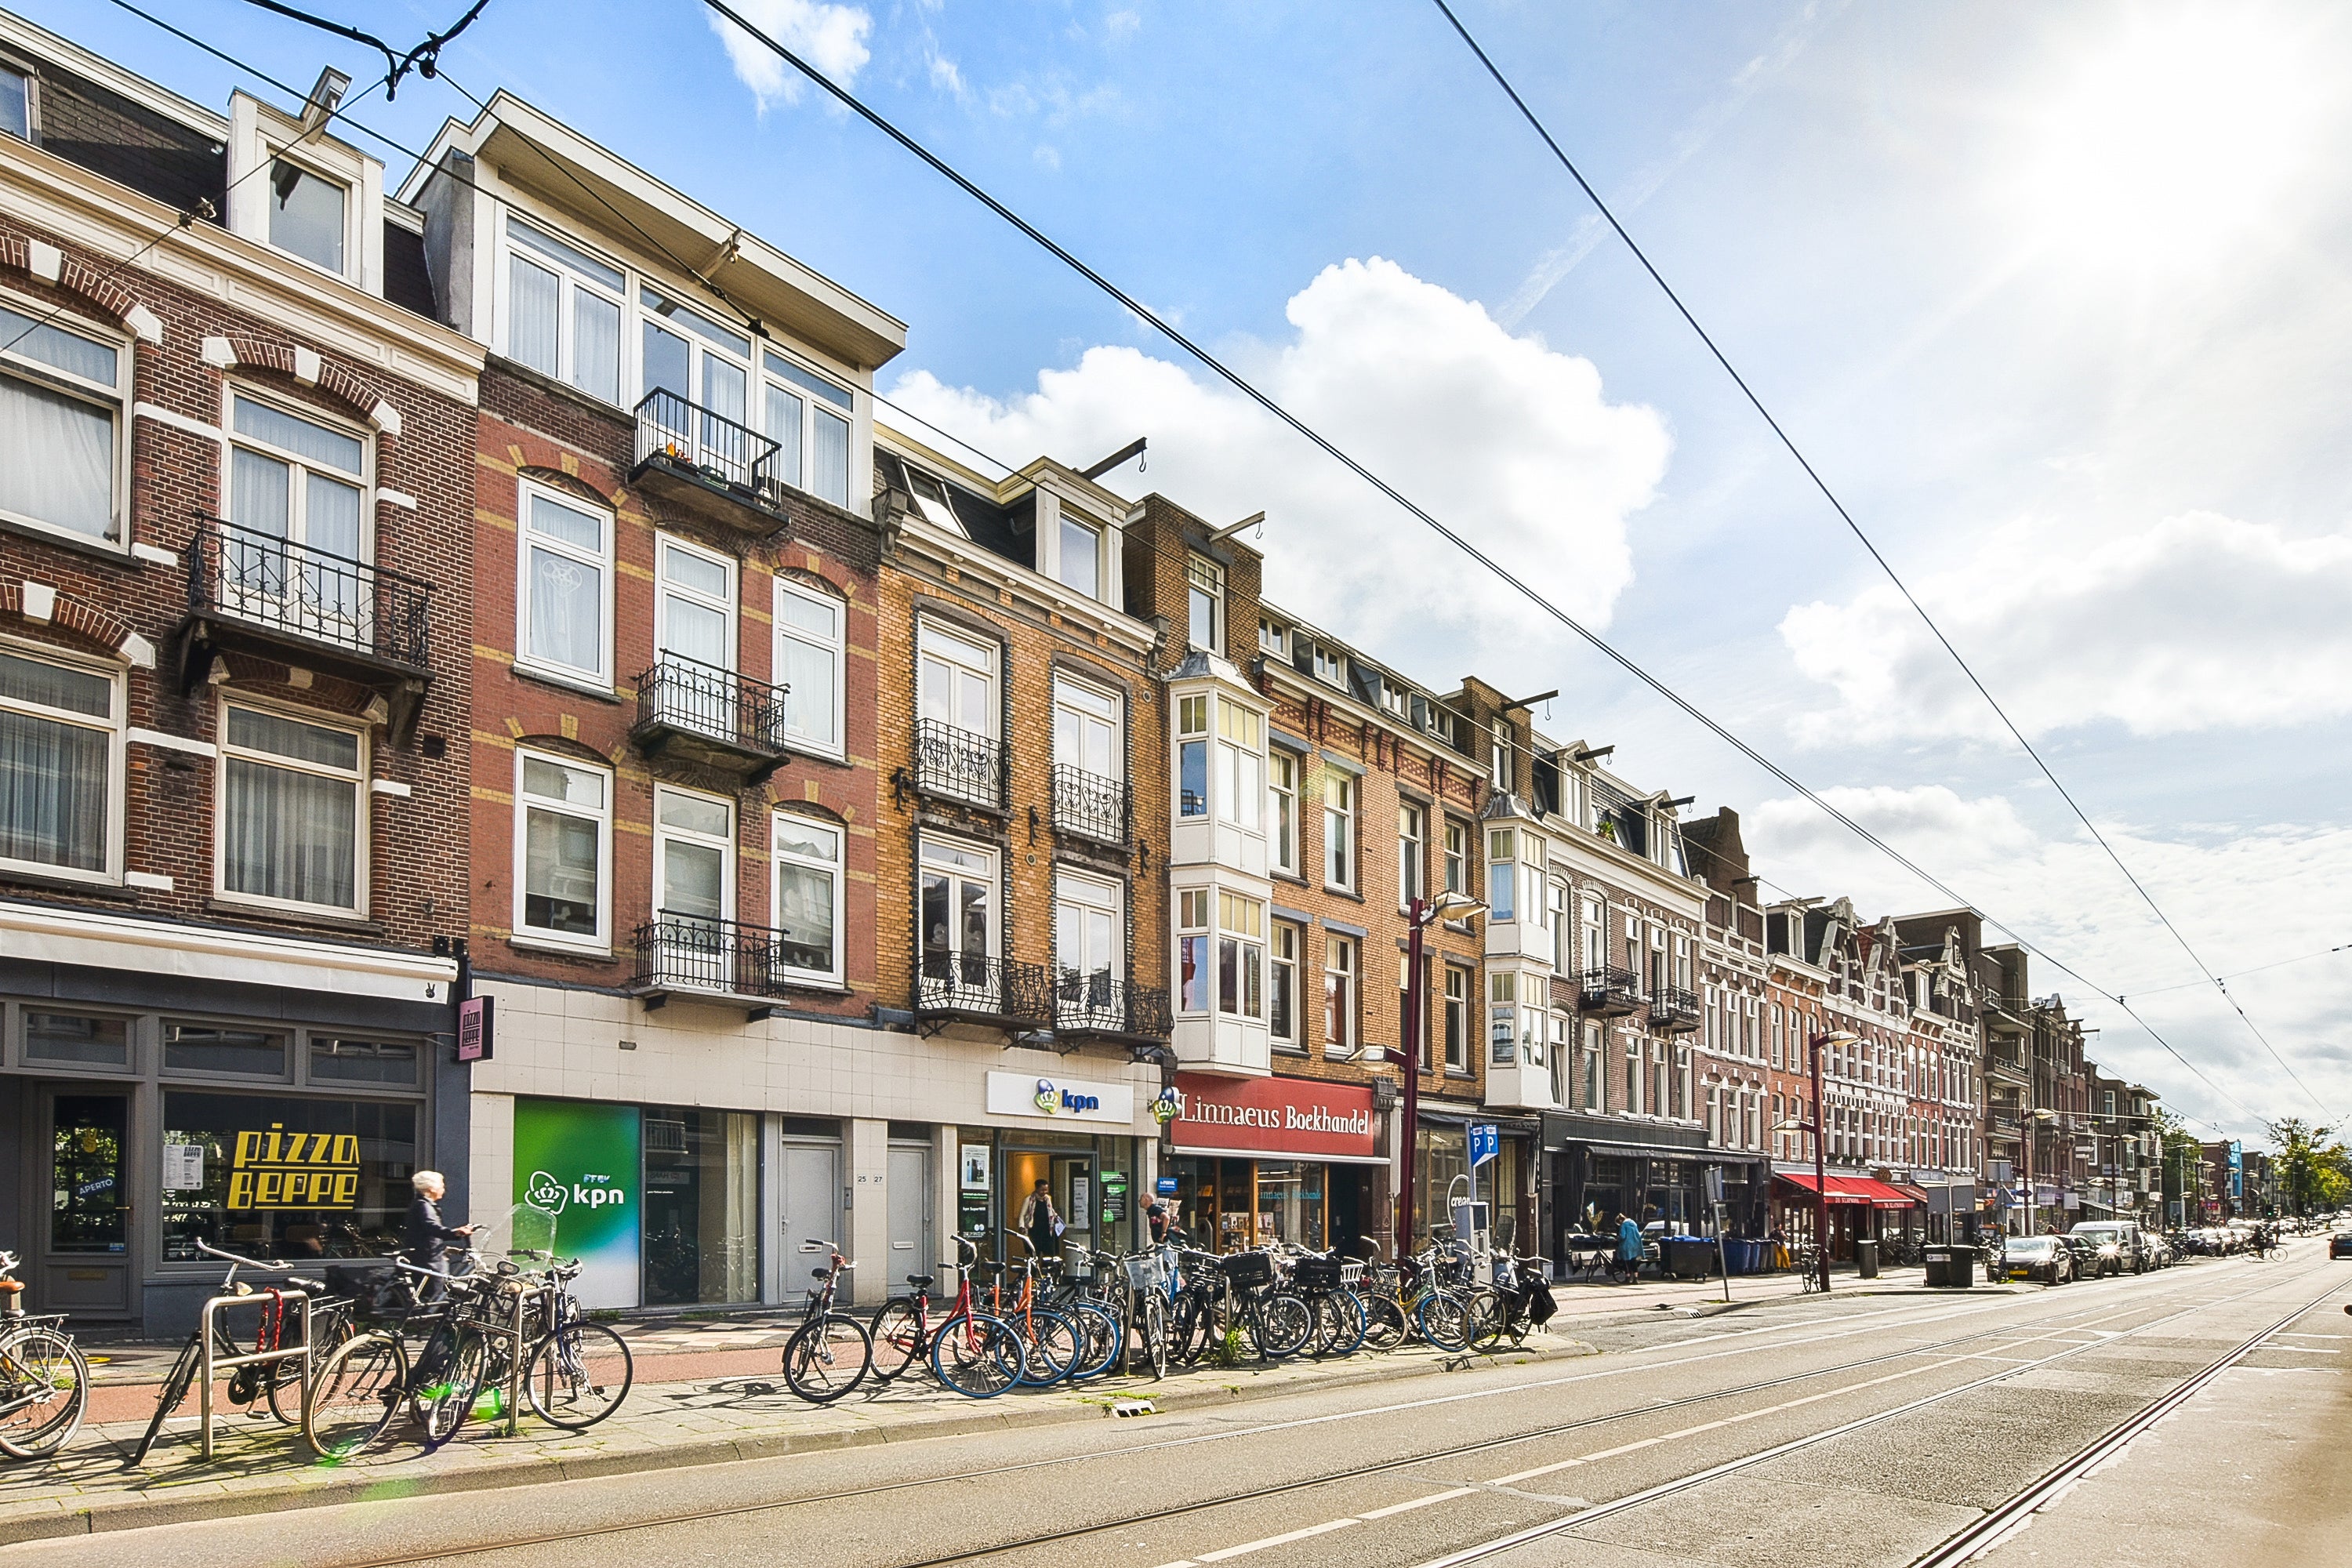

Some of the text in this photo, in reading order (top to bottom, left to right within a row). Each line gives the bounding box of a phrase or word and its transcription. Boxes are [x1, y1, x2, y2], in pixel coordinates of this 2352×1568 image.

[1062, 1089, 1099, 1113] kpn
[1178, 1093, 1370, 1135] Linnaeus Boekhandel
[233, 1123, 360, 1168] pizza
[1474, 1137, 1481, 1153] P
[1487, 1136, 1494, 1152] P
[79, 1178, 114, 1195] APERTO
[227, 1171, 358, 1210] Beppe
[573, 1183, 625, 1209] kpn
